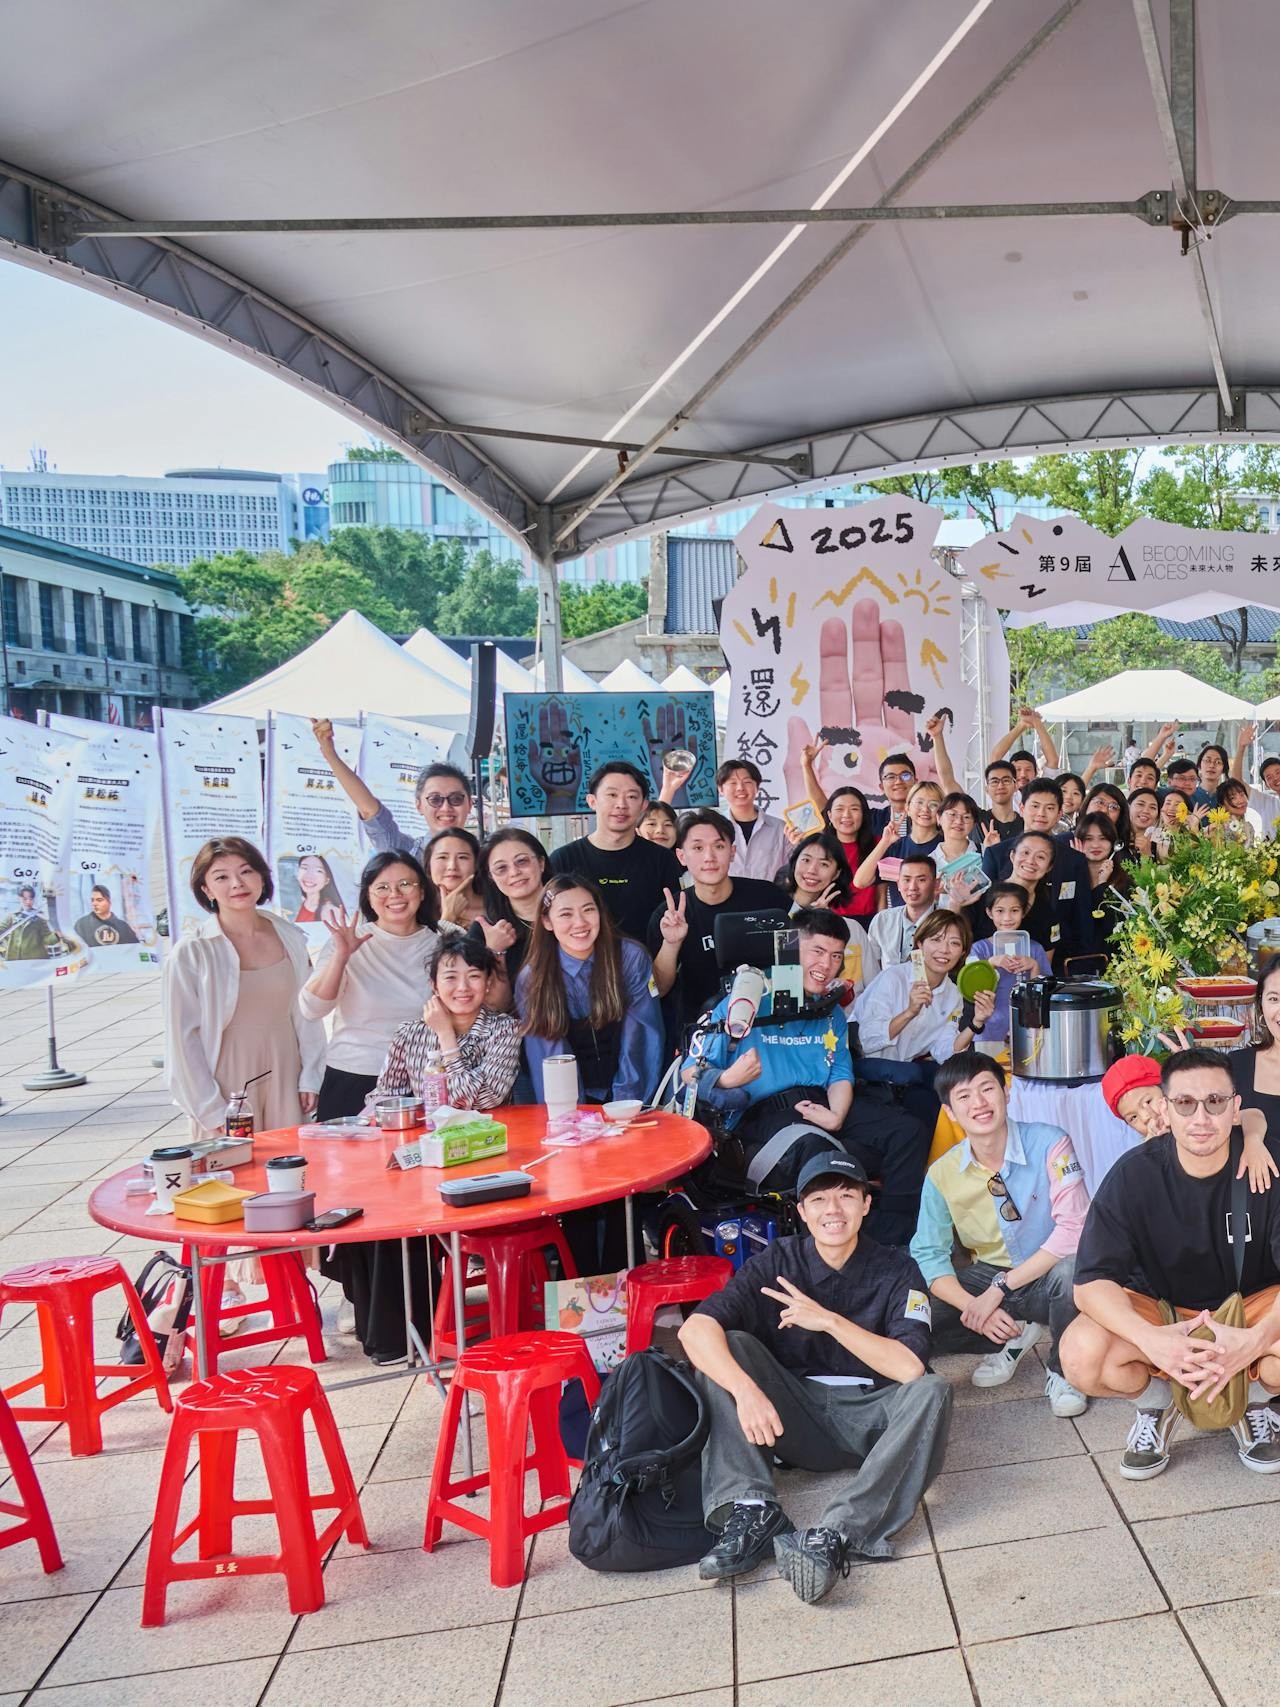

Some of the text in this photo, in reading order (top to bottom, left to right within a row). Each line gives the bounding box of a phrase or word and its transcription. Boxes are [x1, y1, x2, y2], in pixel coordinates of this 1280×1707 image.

[811, 512, 914, 553] 2025
[1142, 545, 1234, 562] BECOMING
[1038, 555, 1091, 572] 第9屆
[1142, 563, 1234, 581] ACES 未來大人物
[13, 867, 39, 880] GO!
[81, 861, 101, 872] GO!
[761, 1034, 778, 1045] THE
